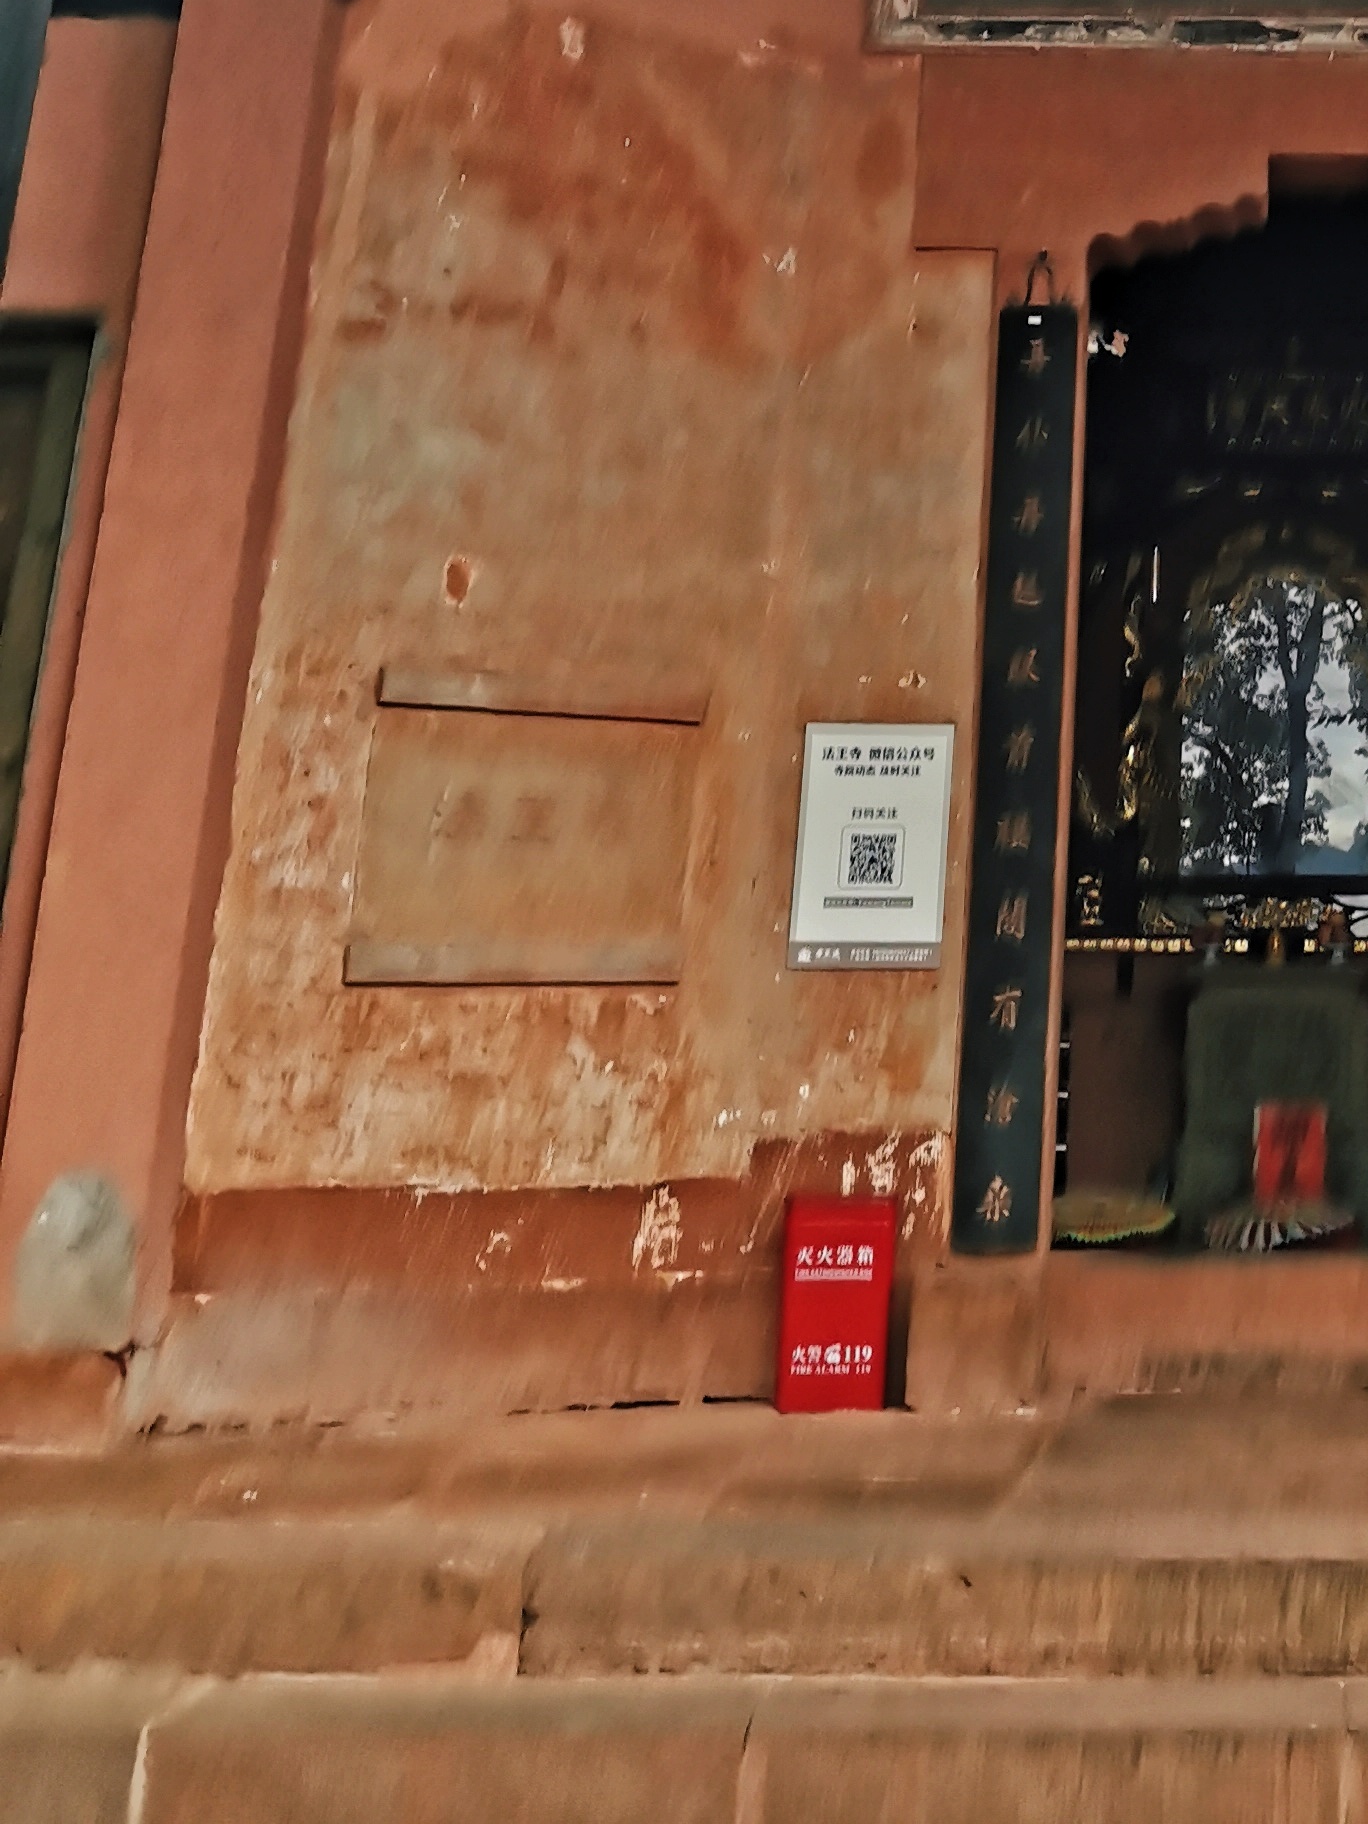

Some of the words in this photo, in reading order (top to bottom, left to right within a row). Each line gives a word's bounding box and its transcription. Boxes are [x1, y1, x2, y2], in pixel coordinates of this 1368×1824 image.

[821, 745, 862, 762] 法王寺
[869, 745, 936, 762] 微信公众号
[851, 806, 899, 821] 扫码关注
[796, 1244, 874, 1267] 灭火器箱
[844, 1344, 873, 1364] 119
